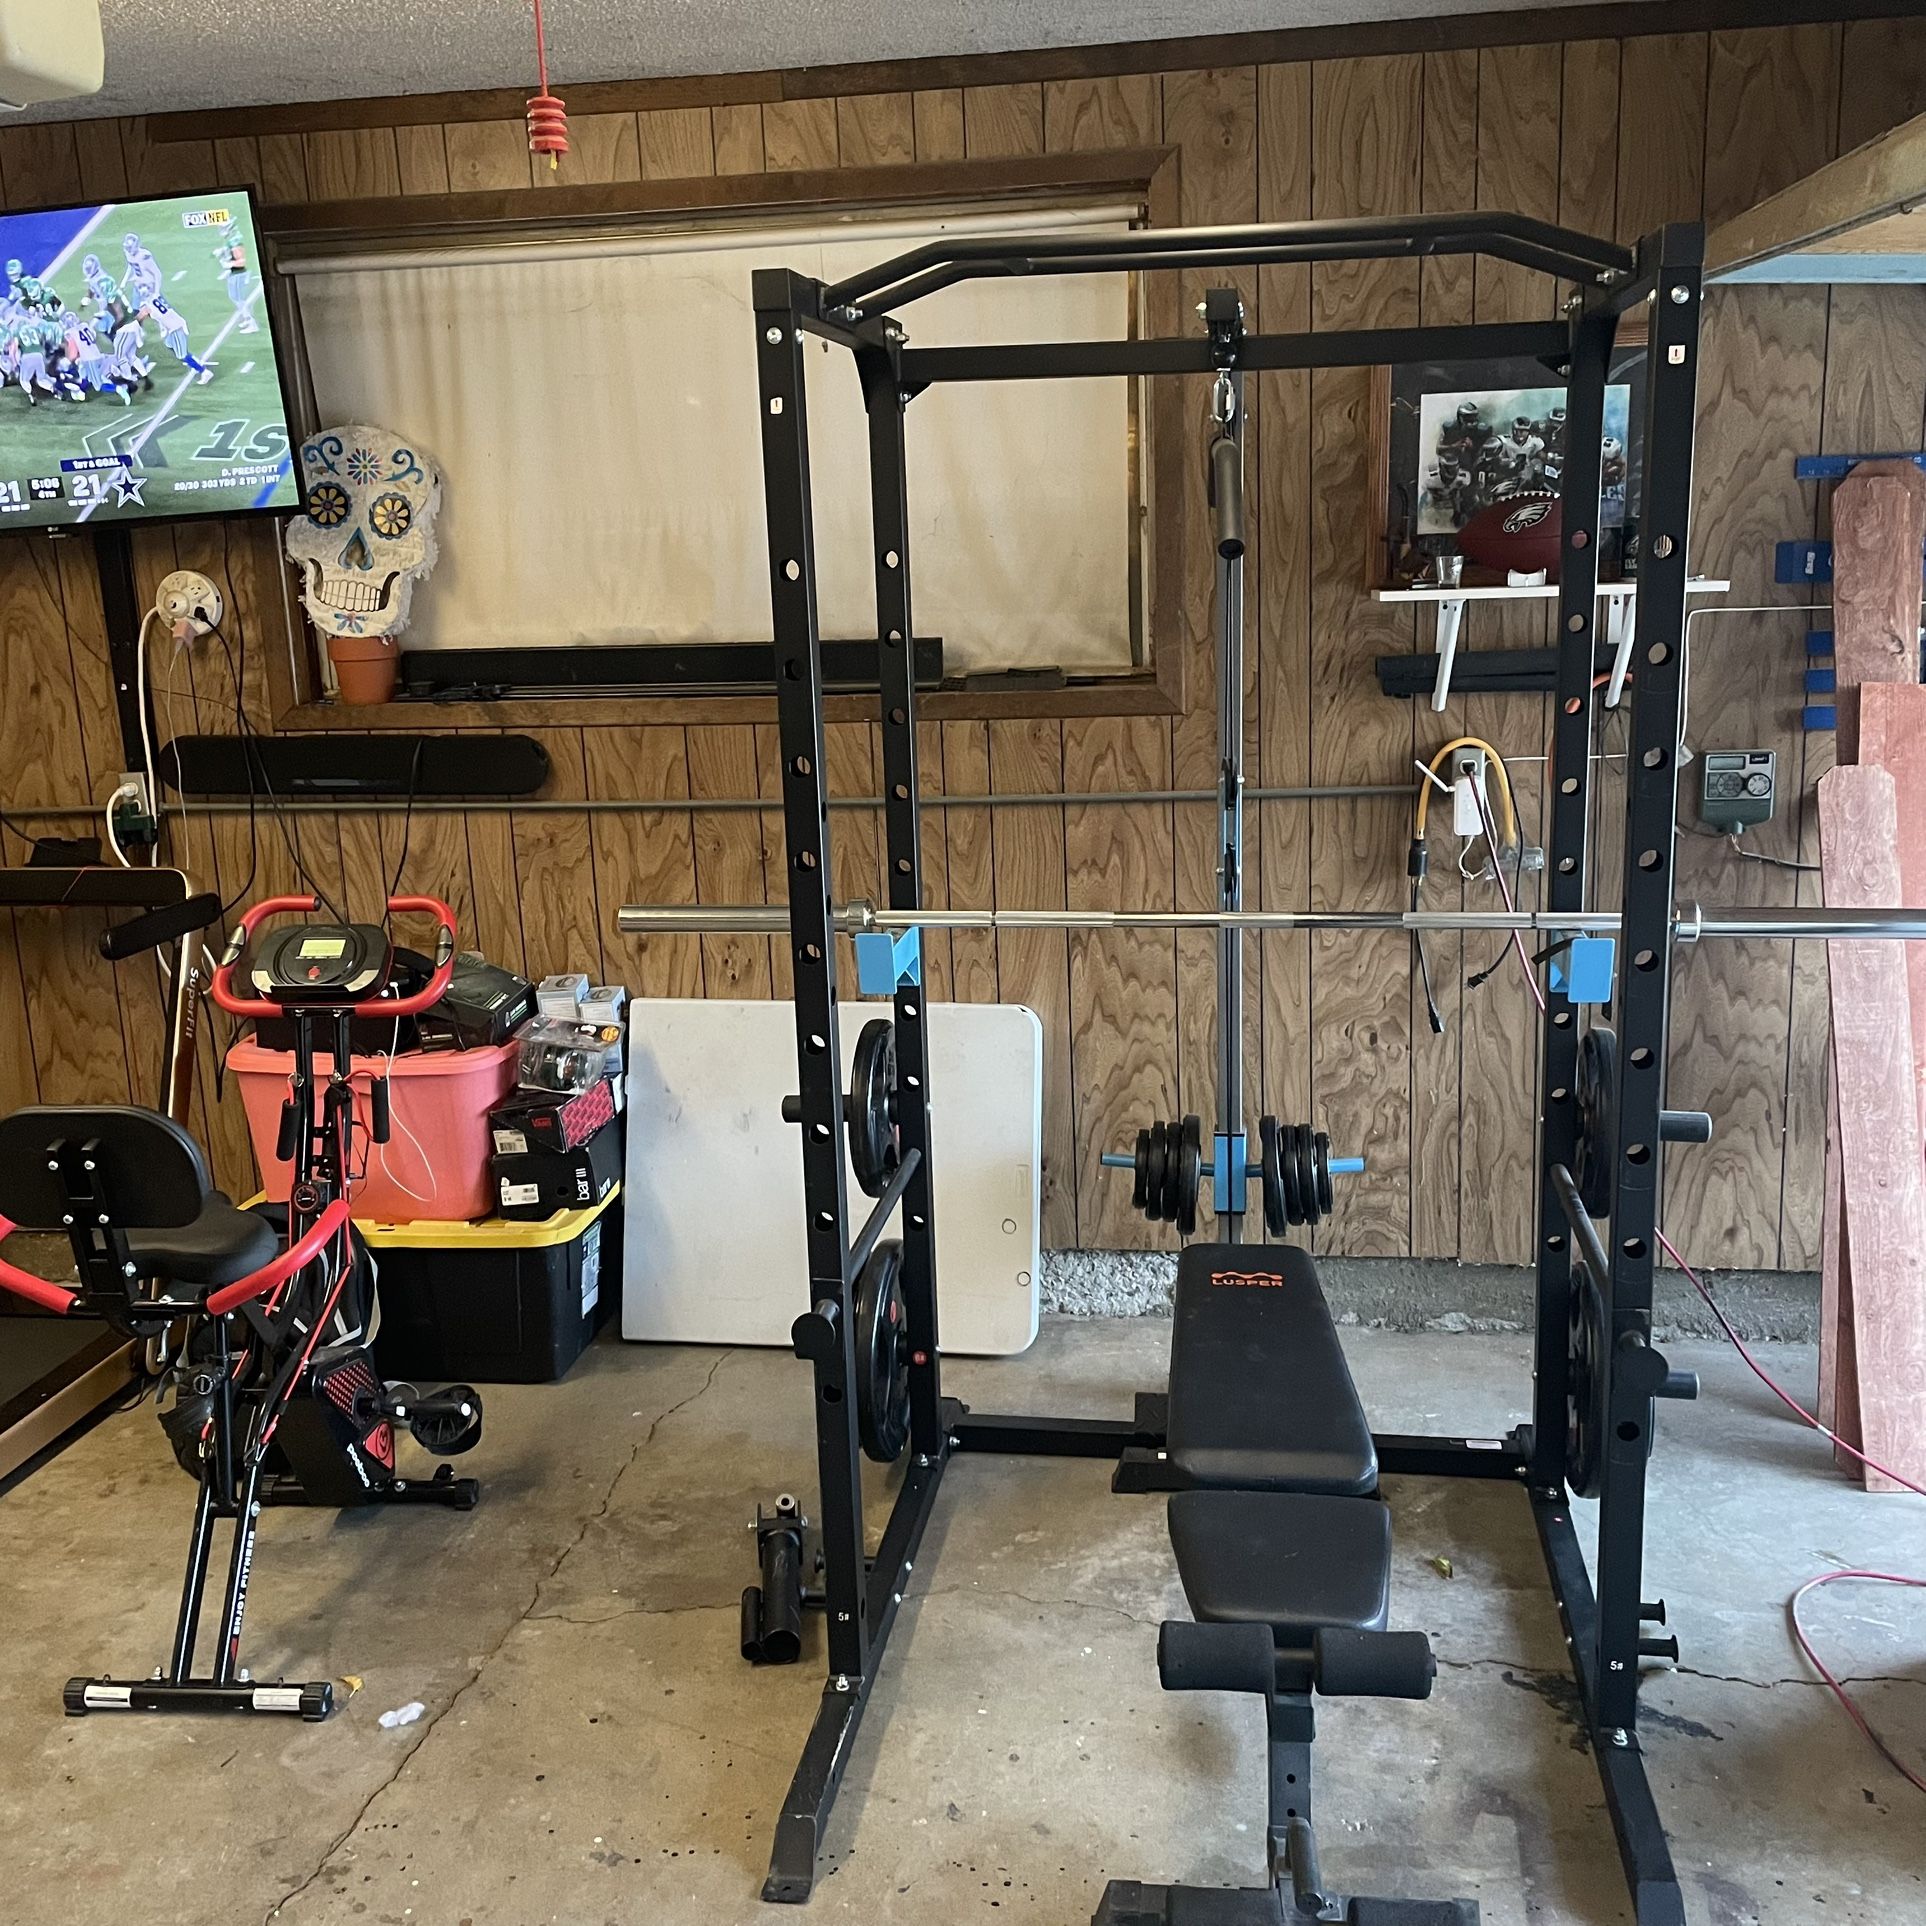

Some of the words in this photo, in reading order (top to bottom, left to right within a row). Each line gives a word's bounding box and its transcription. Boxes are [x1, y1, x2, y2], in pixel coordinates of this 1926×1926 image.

[184, 213, 207, 225] FOX
[208, 211, 228, 223] NFL
[95, 457, 120, 468] GOAL
[221, 468, 231, 477] D.
[232, 464, 279, 476] PRESCOTT
[71, 474, 101, 497] 21
[576, 1179, 590, 1201] bar
[232, 1592, 246, 1635] ENJOY
[240, 1531, 256, 1589] FITNESS
